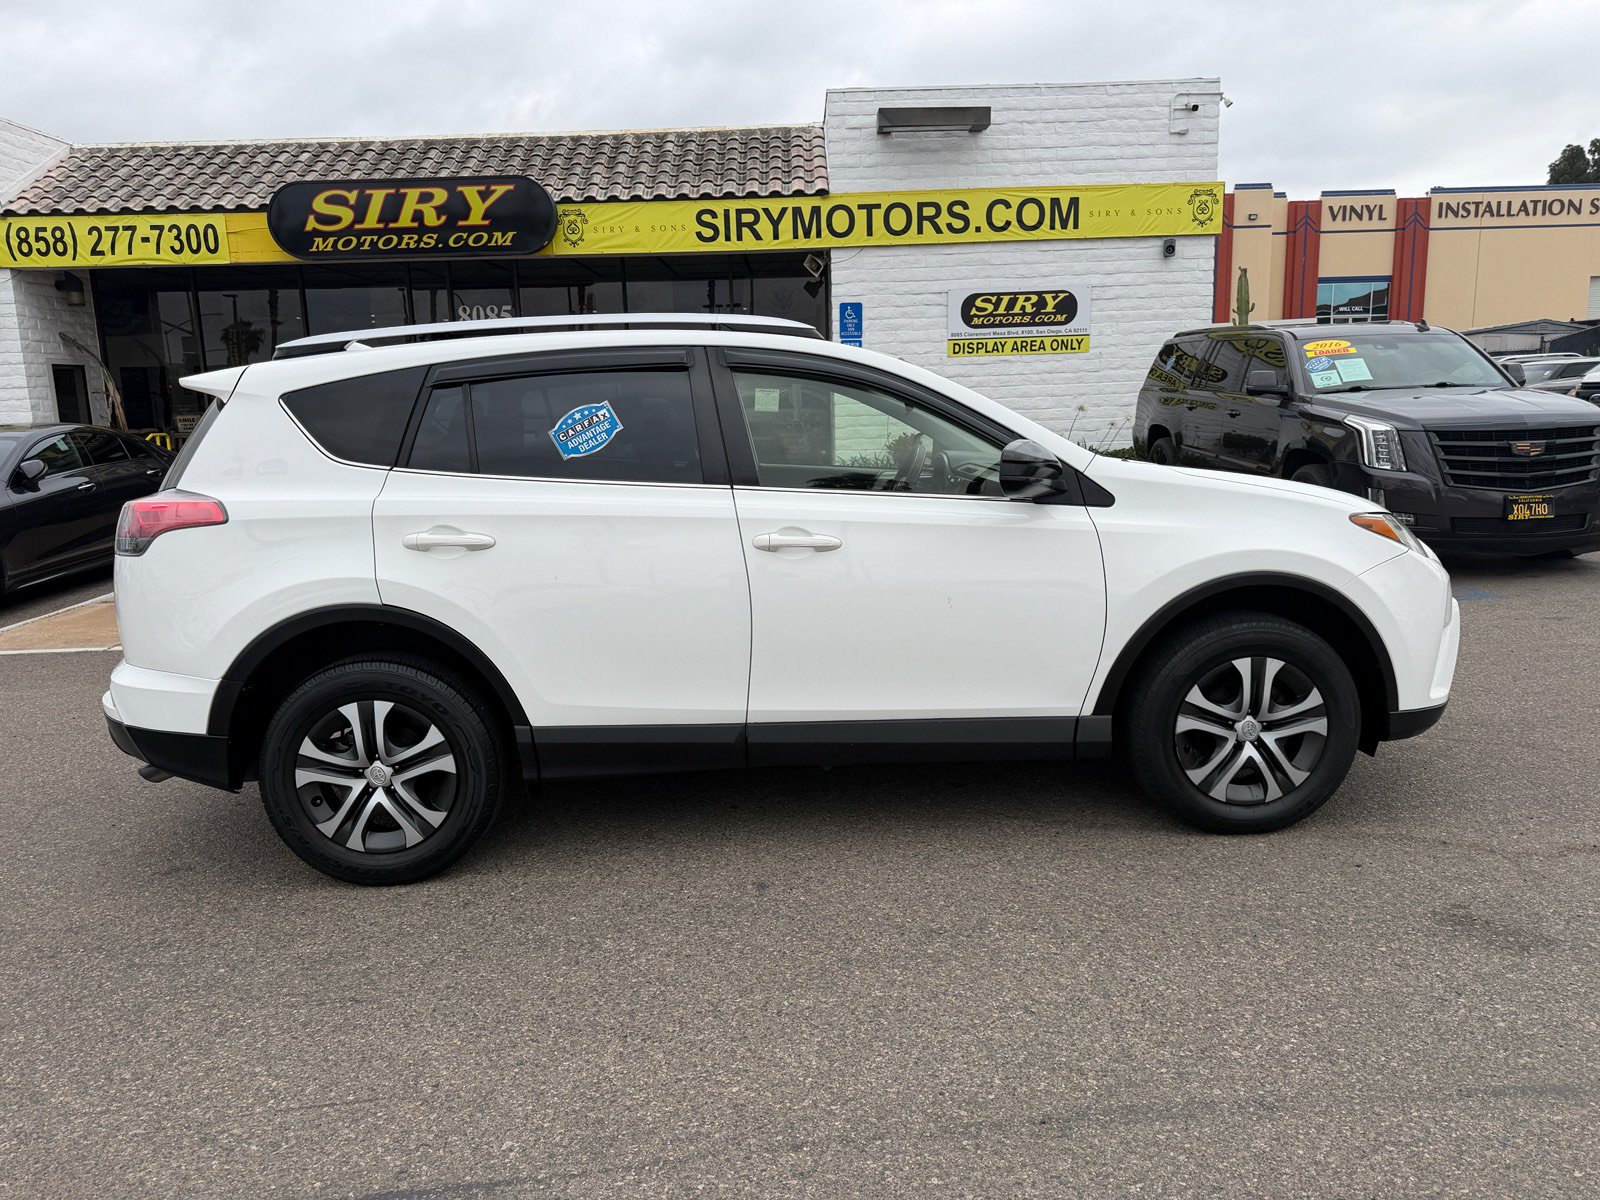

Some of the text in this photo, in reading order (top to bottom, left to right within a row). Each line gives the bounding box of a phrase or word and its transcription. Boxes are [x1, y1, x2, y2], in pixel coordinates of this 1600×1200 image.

[304, 183, 516, 232] SIRY
[1089, 209, 1121, 218] SIRY
[1146, 207, 1182, 216] SONS
[1328, 204, 1388, 222] VINYL
[1437, 199, 1583, 219] INSTALLATION
[593, 225, 625, 234] SIRY
[650, 224, 686, 232] SONS
[695, 197, 1080, 243] SIRYMOTORS.COM
[5, 222, 220, 261] (858) 277-7300
[309, 231, 518, 252] MOTORS.COM
[970, 293, 1069, 316] SIRY
[970, 314, 1068, 325] MOTORS.COM
[952, 338, 1085, 355] DISPLAY AREA ONLY
[1313, 341, 1342, 350] 2016
[1314, 347, 1350, 356] LOADED
[557, 411, 609, 442] CARFAX
[567, 421, 611, 449] ADVANTAGE
[578, 432, 608, 452] DEALER
